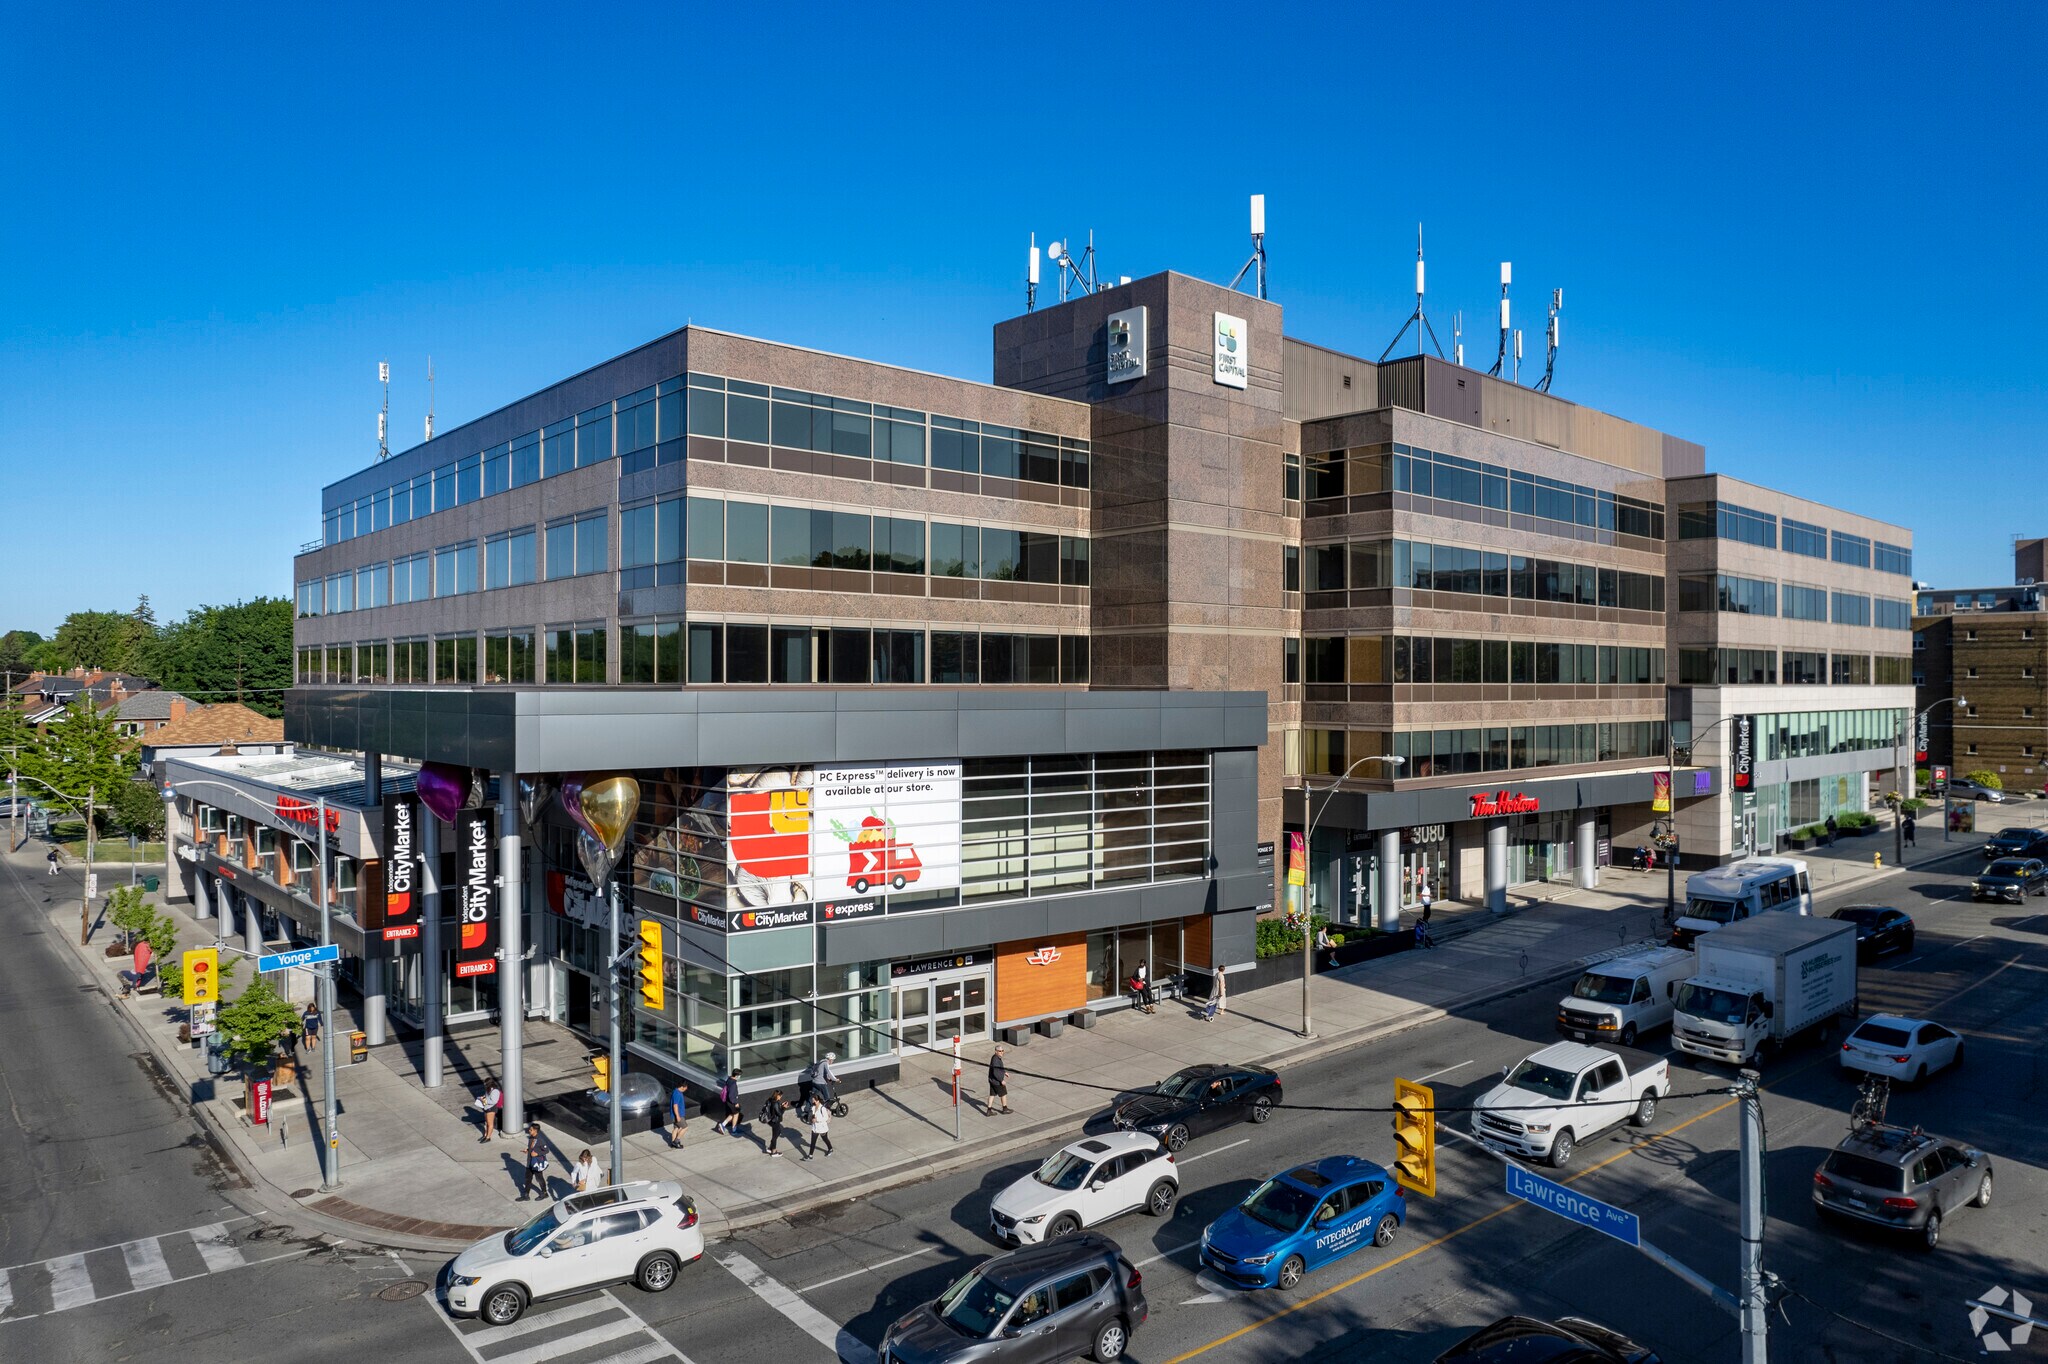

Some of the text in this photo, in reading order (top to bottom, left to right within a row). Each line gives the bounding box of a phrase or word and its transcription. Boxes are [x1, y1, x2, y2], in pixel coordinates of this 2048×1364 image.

[1218, 353, 1237, 365] FIRST
[1218, 364, 1246, 378] CAPITAL
[820, 773, 833, 782] PC
[887, 769, 924, 780] delivery
[926, 767, 935, 777] is
[937, 768, 956, 777] now
[825, 783, 934, 797] available at our store.
[1470, 789, 1541, 818] Tim Hortons
[1411, 824, 1445, 845] 3080
[394, 803, 414, 892] CityMarket
[469, 820, 491, 923] CityMarket
[834, 902, 875, 916] express
[697, 912, 726, 928] CityMarket
[755, 911, 808, 927] CityMarket
[386, 928, 412, 938] ENTRANCE
[278, 952, 312, 966] Yonge
[910, 960, 953, 973] LAWRENCE
[460, 964, 488, 974] ENTRANCE
[1515, 1170, 1624, 1224] Lawrence Ave
[1316, 1215, 1372, 1249] INTEGRAcare
